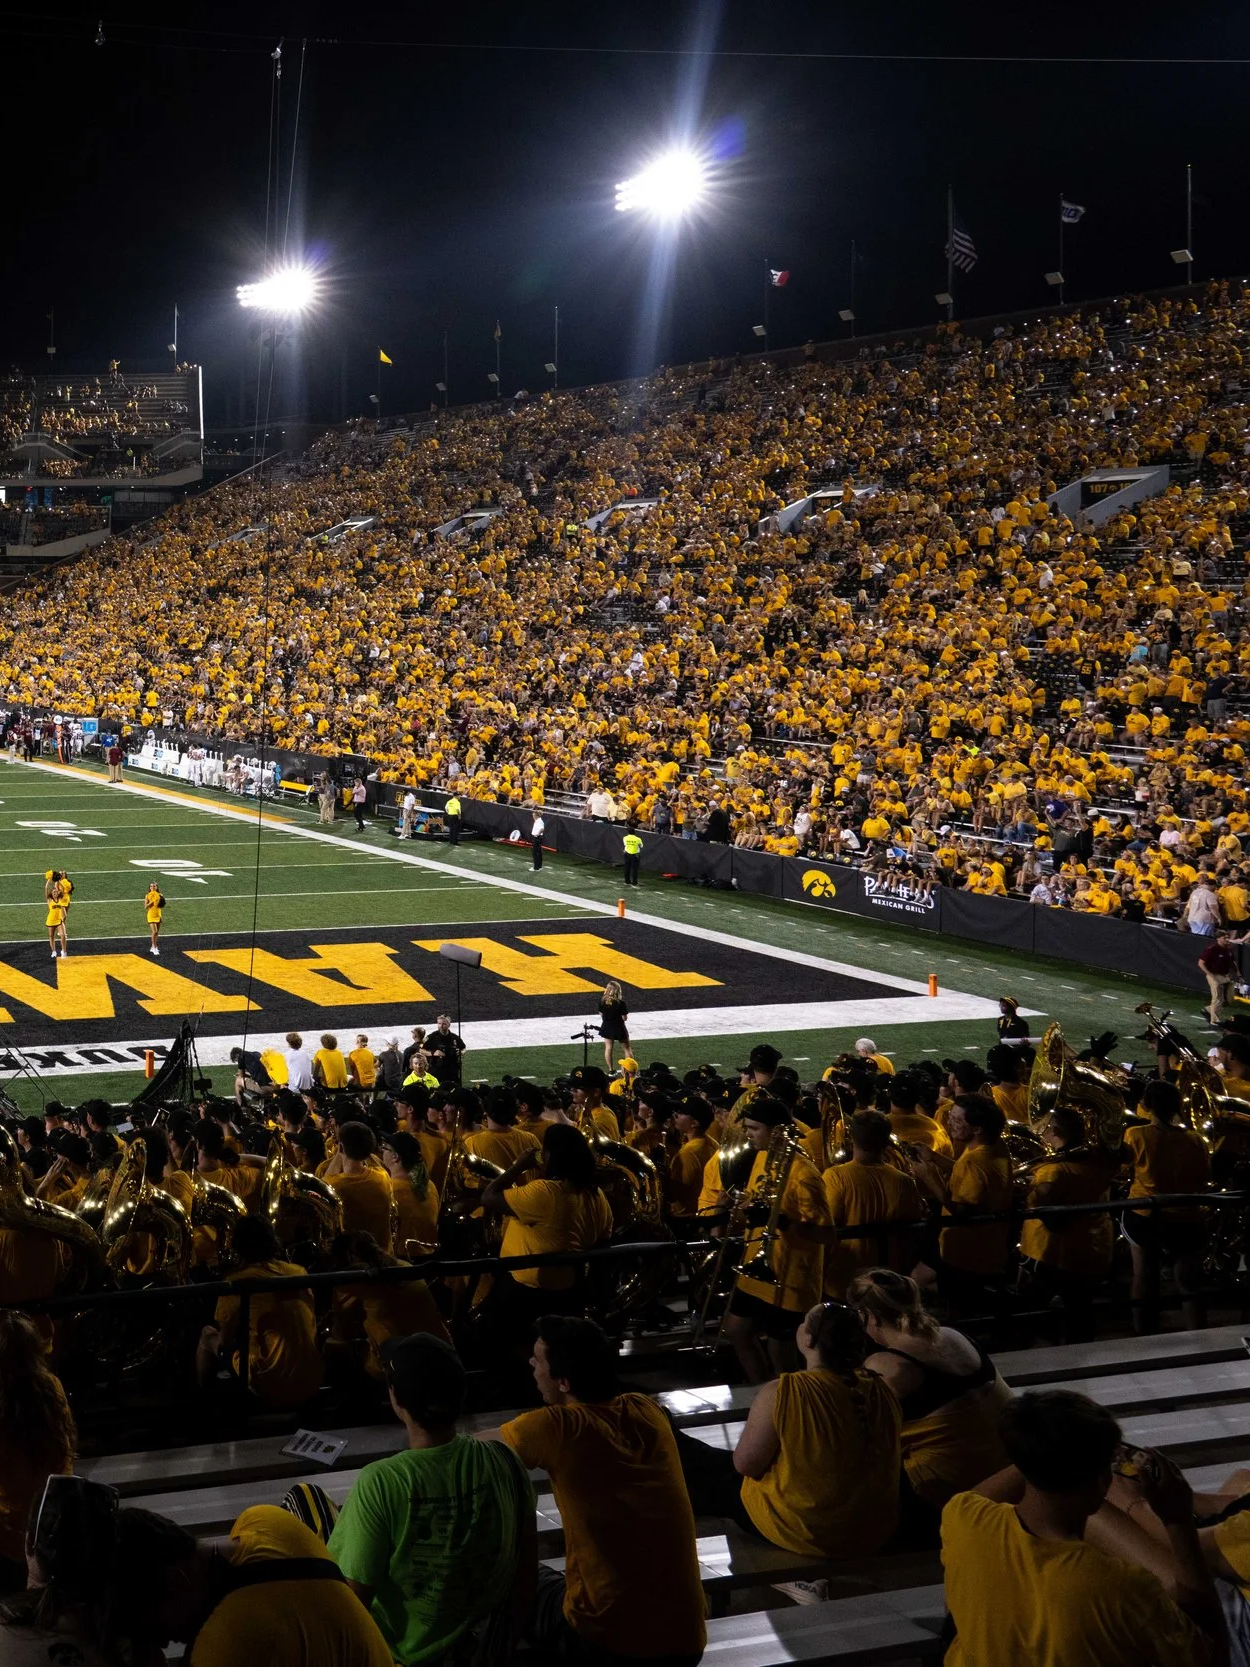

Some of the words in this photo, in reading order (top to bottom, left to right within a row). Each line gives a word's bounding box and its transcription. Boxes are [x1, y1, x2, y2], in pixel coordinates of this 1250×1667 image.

[872, 898, 903, 910] MEXICAN
[905, 904, 926, 914] GRILL
[794, 1581, 817, 1593] HOKA
